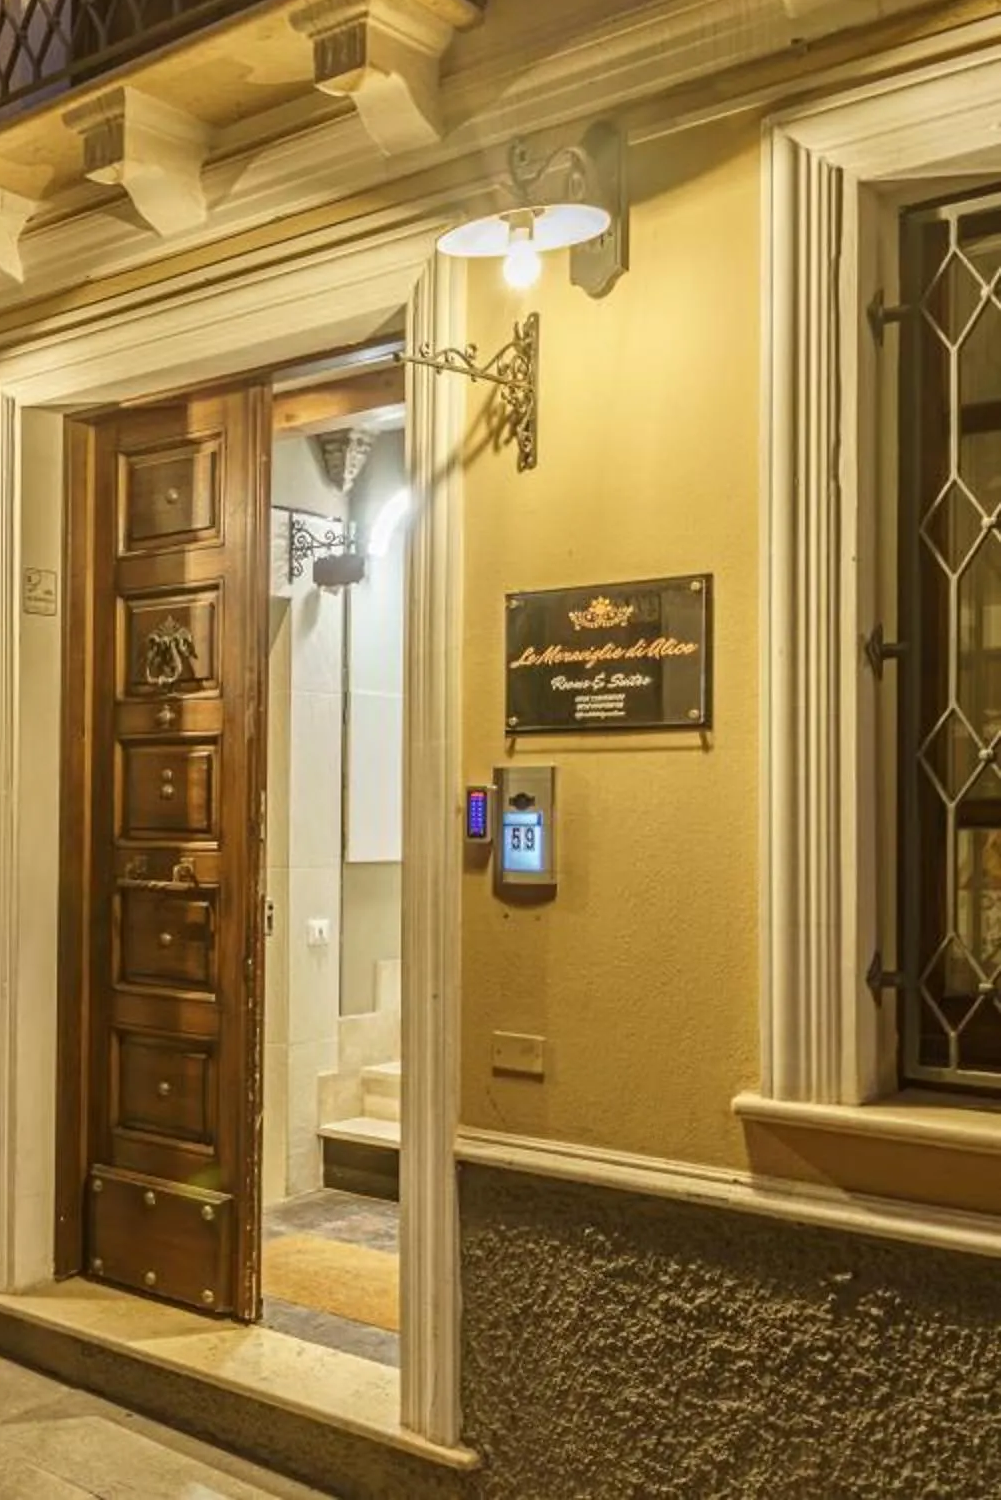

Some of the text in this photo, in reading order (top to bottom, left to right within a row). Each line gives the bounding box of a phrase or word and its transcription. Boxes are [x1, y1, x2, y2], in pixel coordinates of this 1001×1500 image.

[509, 646, 537, 668] Le
[624, 638, 647, 659] di
[645, 636, 698, 660] Alice
